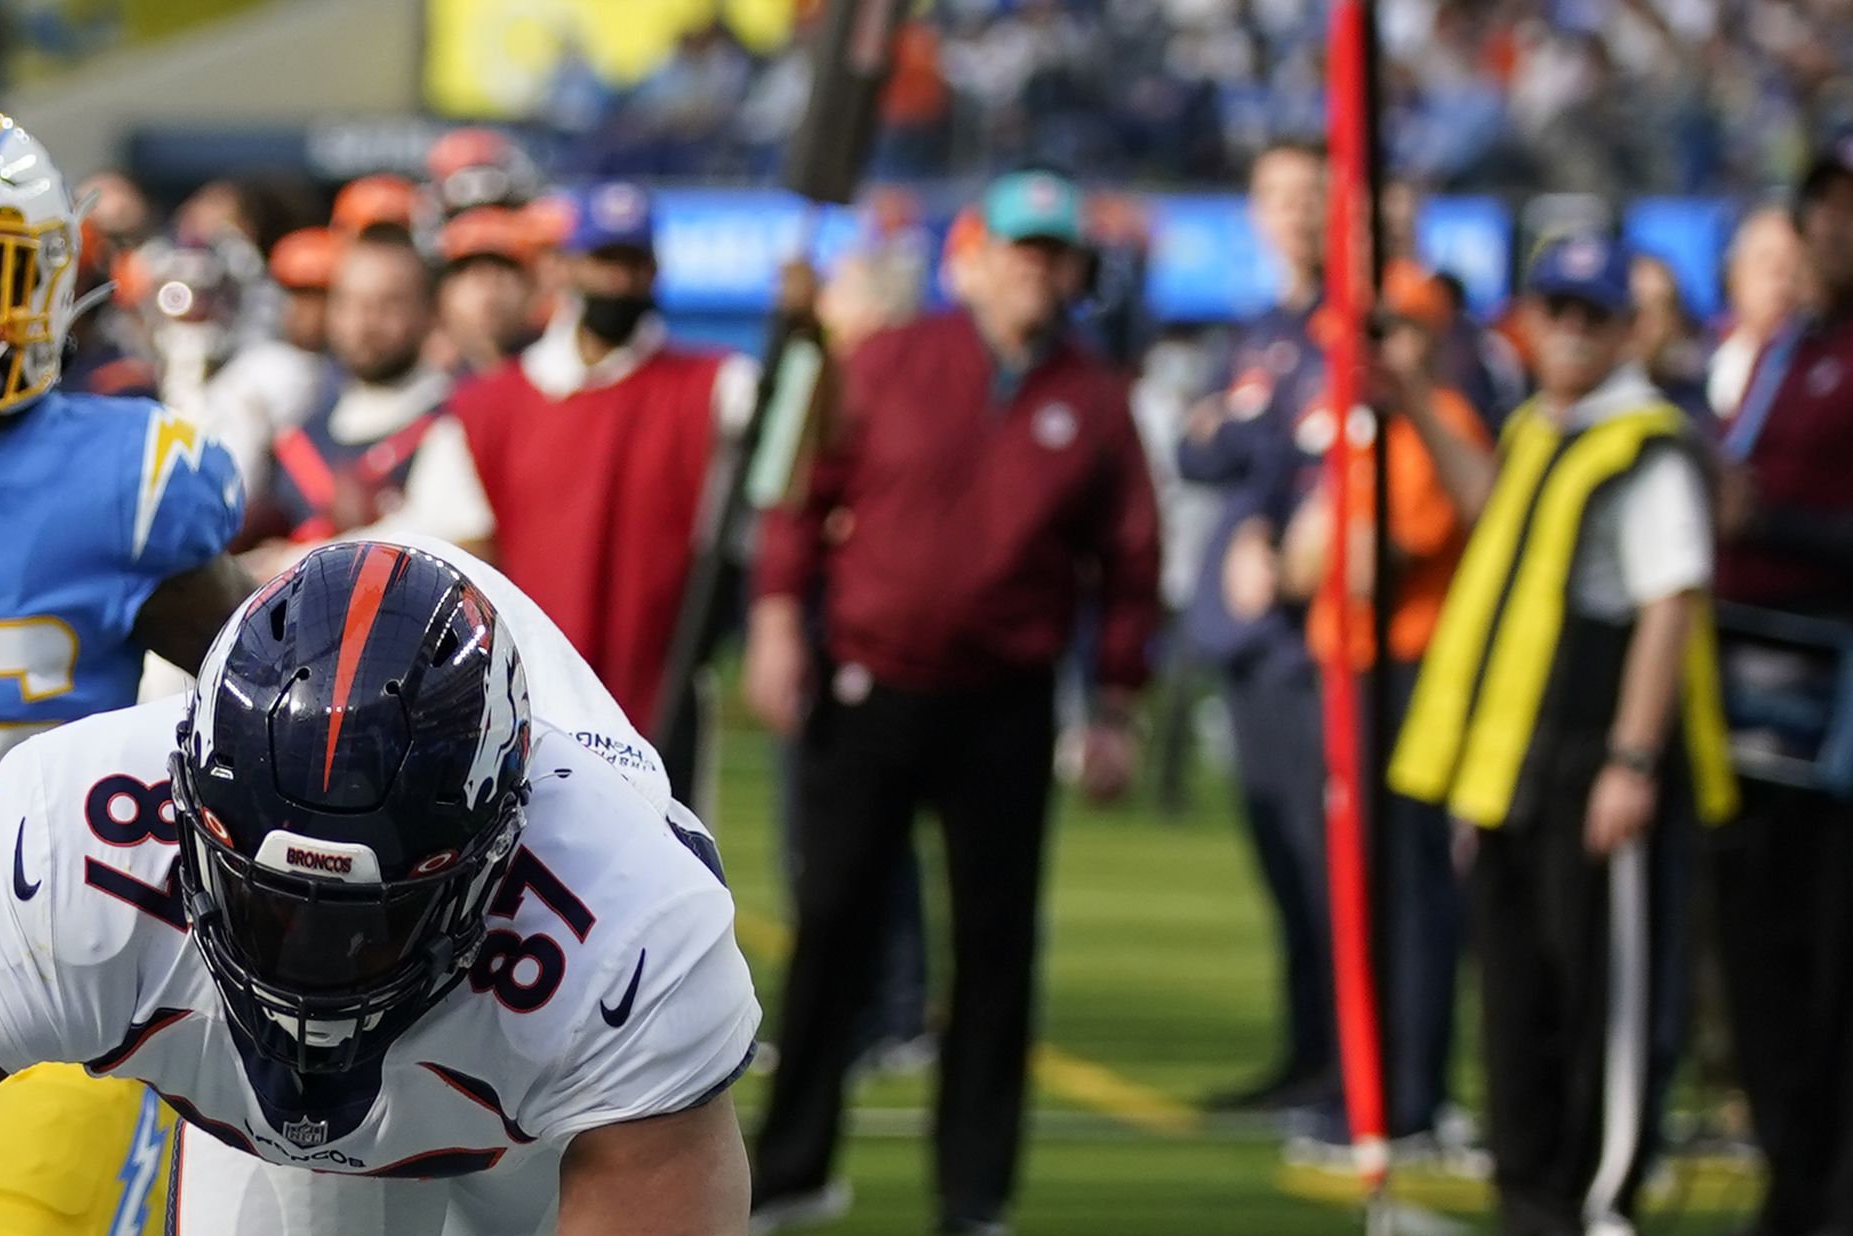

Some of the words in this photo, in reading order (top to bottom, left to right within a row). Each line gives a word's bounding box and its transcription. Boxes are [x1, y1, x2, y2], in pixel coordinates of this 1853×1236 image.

[84, 773, 193, 934] 87
[285, 846, 354, 874] BRONCOS
[469, 844, 597, 1014] 87
